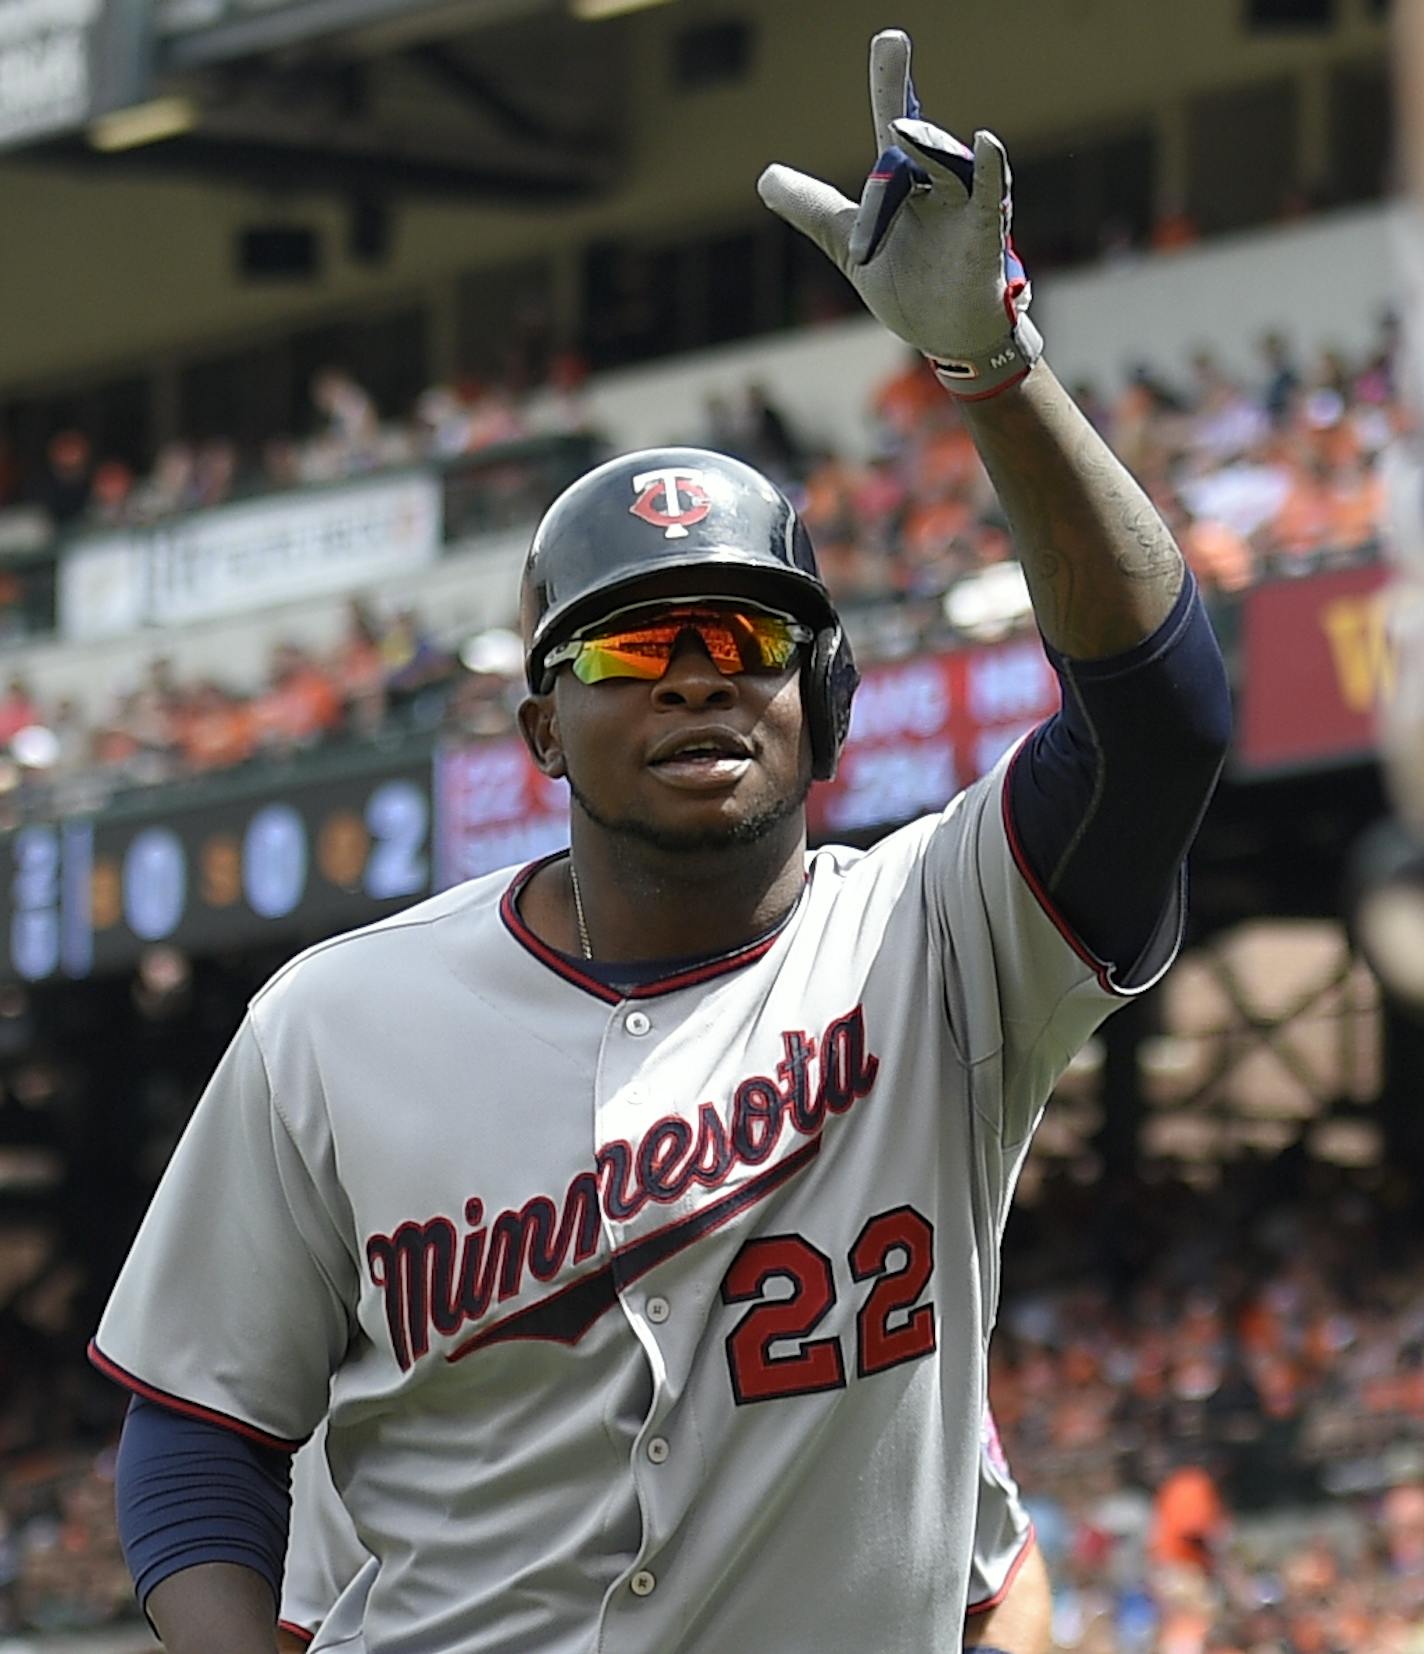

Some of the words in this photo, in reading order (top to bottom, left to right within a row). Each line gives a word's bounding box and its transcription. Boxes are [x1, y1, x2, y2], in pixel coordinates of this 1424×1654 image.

[990, 349, 1016, 368] MS
[365, 780, 429, 898] 2
[367, 1004, 878, 1372] Minnesota
[723, 1205, 936, 1405] 22
